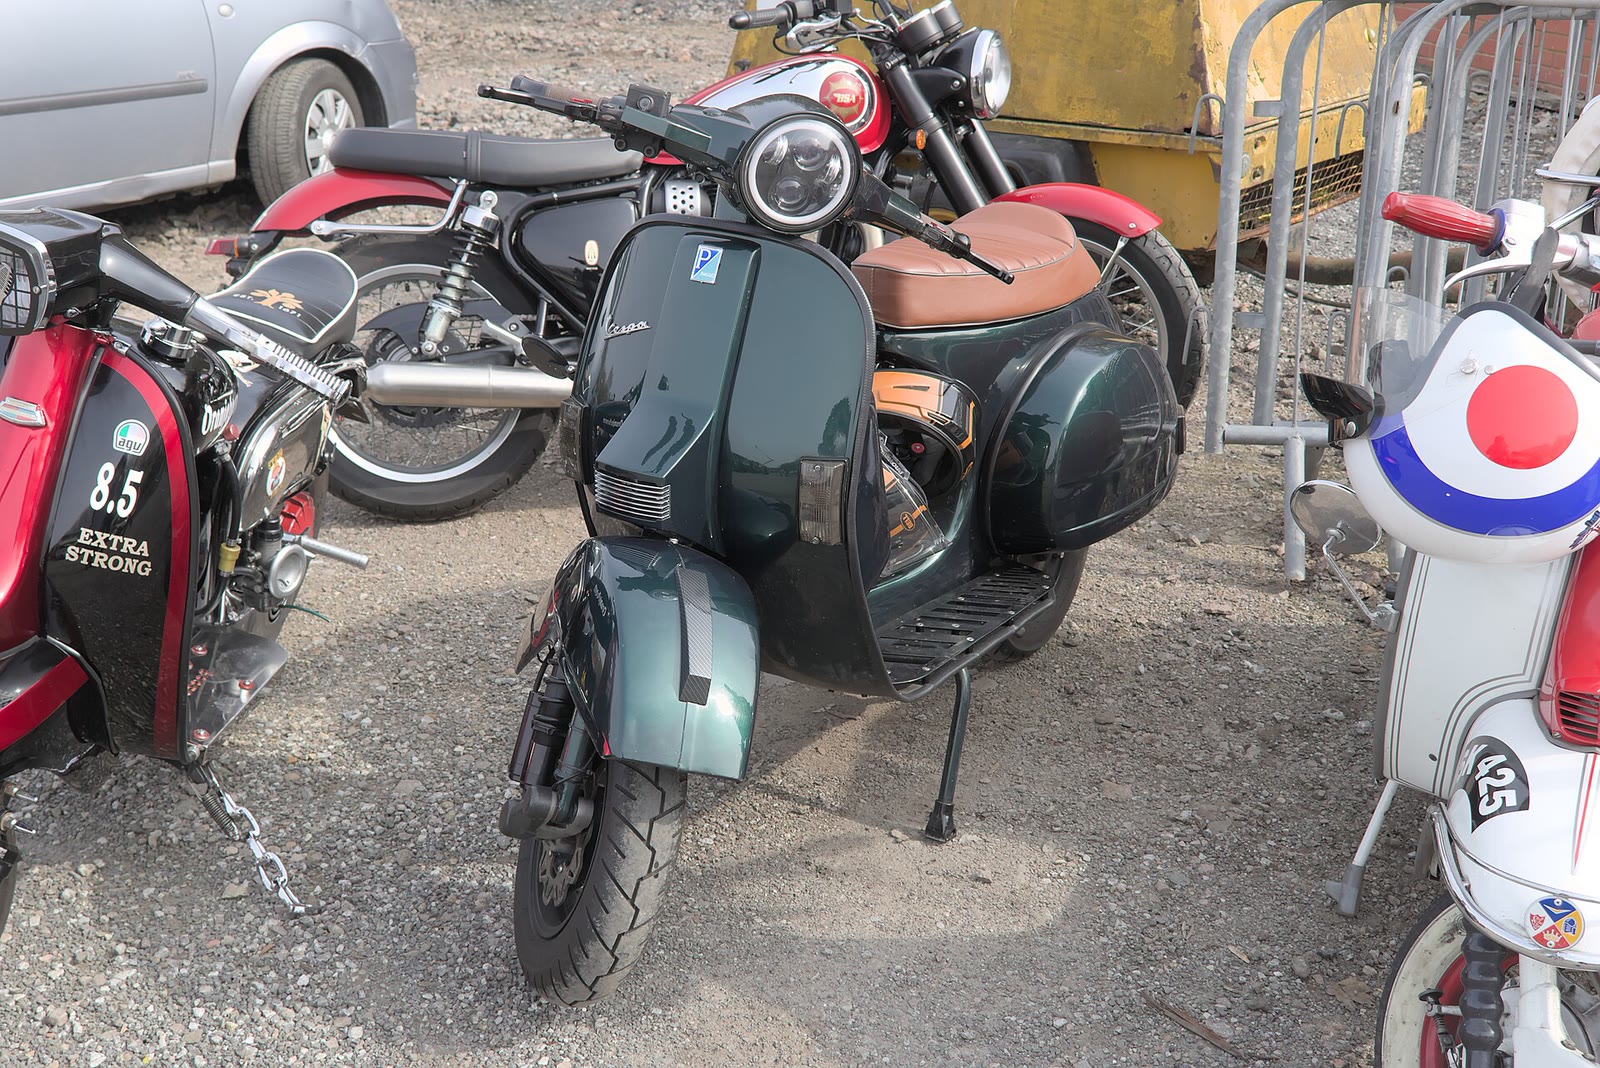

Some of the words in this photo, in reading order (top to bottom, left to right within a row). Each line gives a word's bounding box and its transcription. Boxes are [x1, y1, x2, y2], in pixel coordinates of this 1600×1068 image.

[89, 461, 144, 518] 8.5
[77, 527, 149, 557] EXTRA
[65, 545, 152, 577] STRONG
